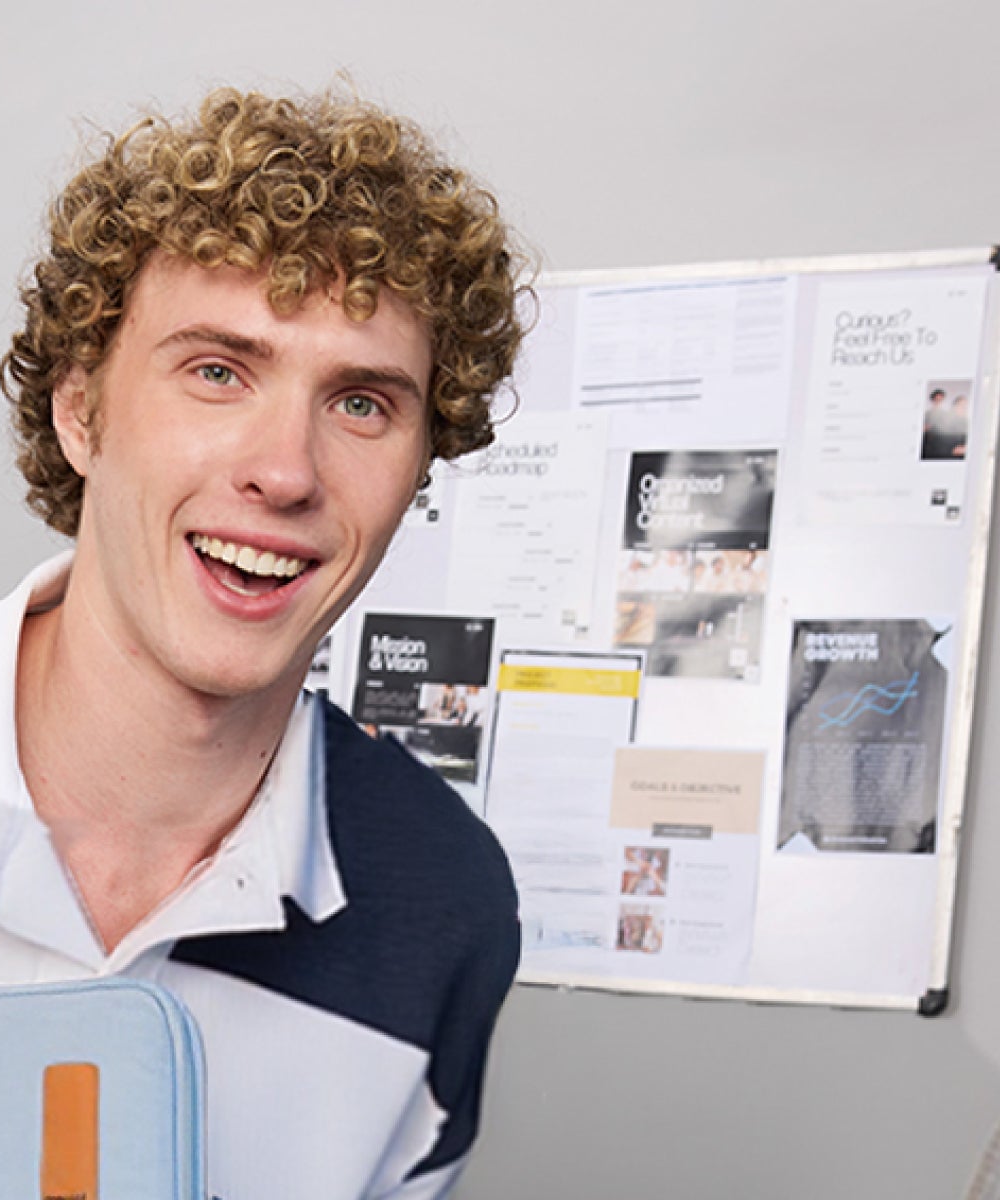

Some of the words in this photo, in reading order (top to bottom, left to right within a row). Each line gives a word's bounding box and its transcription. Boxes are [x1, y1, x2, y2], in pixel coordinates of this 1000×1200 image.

[915, 326, 939, 346] To
[831, 346, 887, 365] Reach
[890, 344, 914, 365] Us
[370, 634, 427, 654] Mission
[384, 652, 430, 672] Vision
